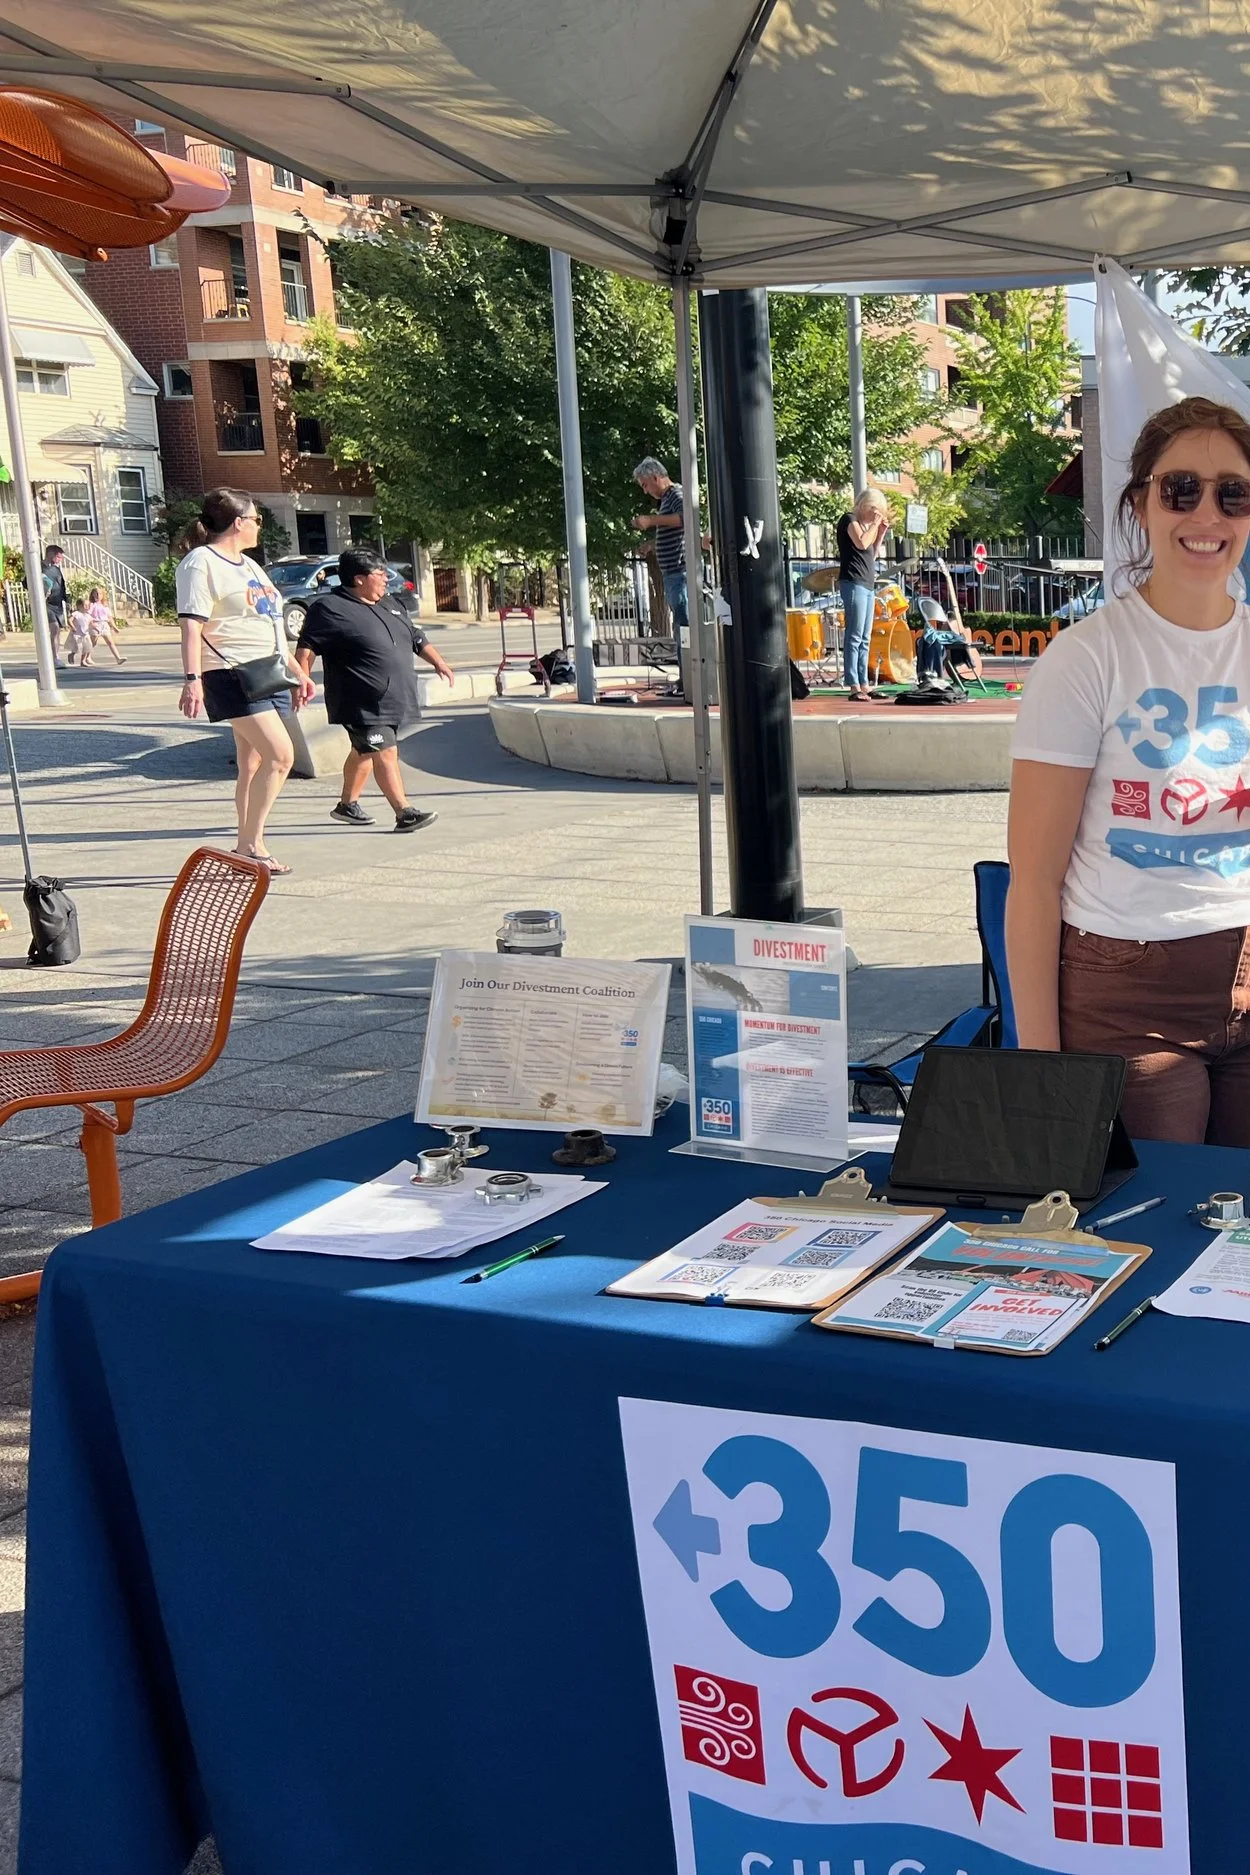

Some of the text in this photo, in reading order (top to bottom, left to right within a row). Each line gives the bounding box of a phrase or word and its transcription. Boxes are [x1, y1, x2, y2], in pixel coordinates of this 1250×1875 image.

[754, 939, 826, 962] DIVESTMENT
[459, 978, 636, 998] Join Our Divestment Coalition
[744, 1019, 821, 1035] MOMENTUM FOR DIVESTMENT
[787, 1067, 813, 1077] EFFECTIVE
[706, 1099, 731, 1115] 350
[982, 1241, 1019, 1249] CHICAGO
[969, 1303, 1063, 1316] INVOLVED
[1002, 1297, 1042, 1306] GET
[702, 1434, 1157, 1708] 350
